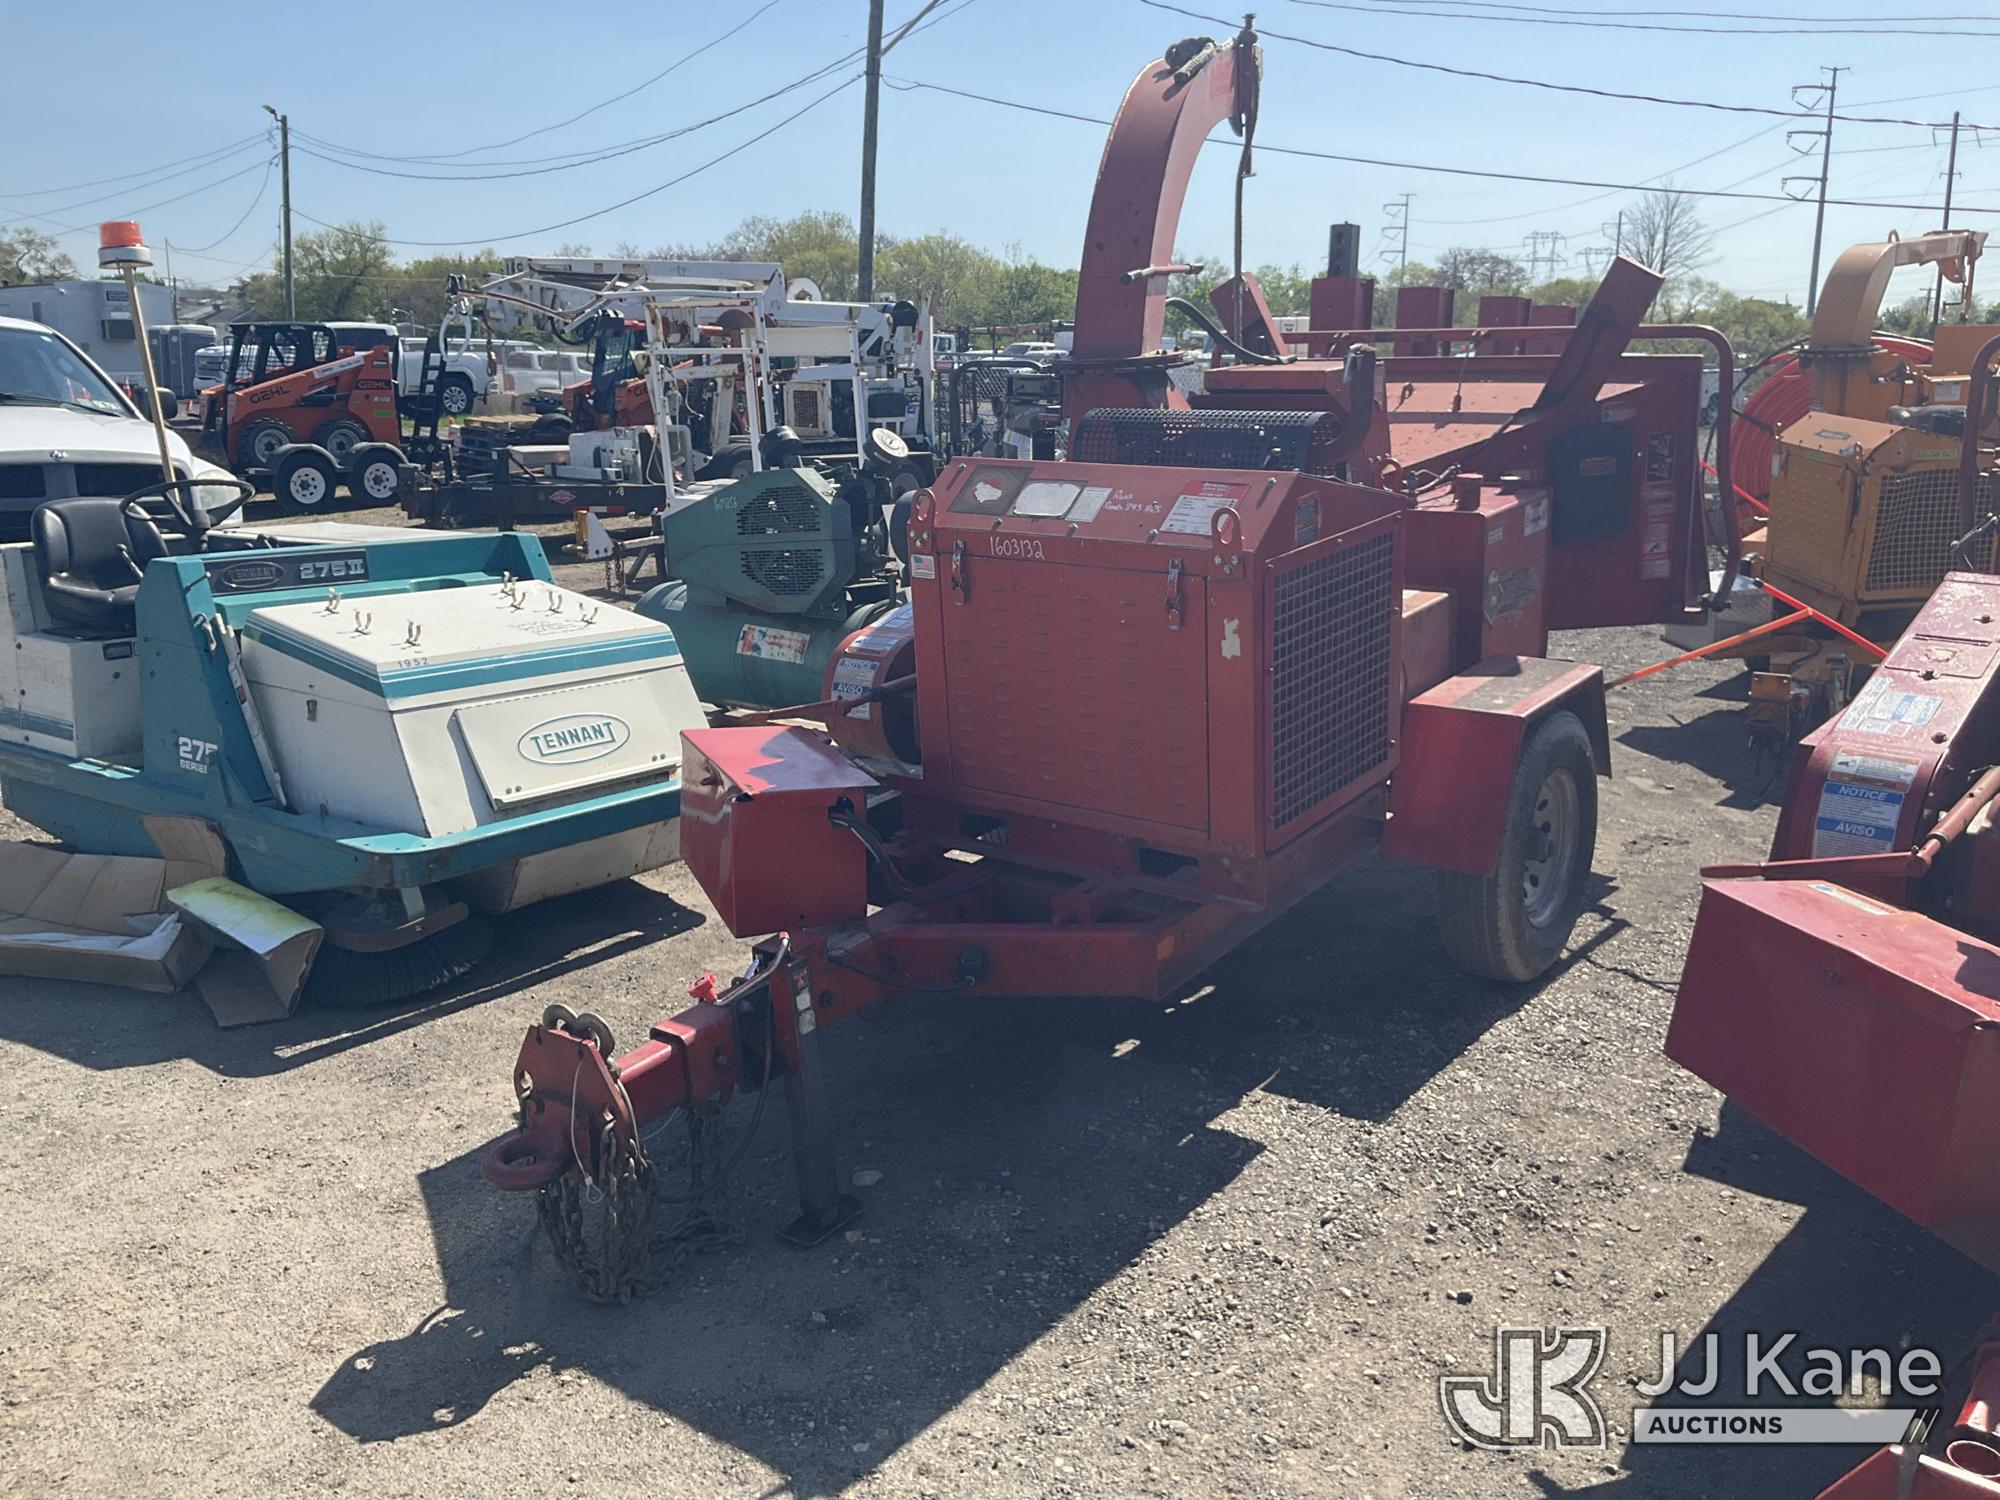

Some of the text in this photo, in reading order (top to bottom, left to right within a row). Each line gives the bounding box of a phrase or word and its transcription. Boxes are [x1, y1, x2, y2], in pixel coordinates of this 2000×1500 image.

[358, 380, 390, 389] GEHL
[249, 385, 290, 404] GEHL
[989, 536, 1045, 560] 1603132
[397, 656, 429, 669] 1952
[843, 658, 874, 670] NOTICE
[837, 683, 863, 695] AVISO
[529, 720, 616, 757] TENNANT
[180, 760, 207, 773] SERIE
[1838, 785, 1889, 801] NOTICE
[1834, 821, 1876, 838] AVISO
